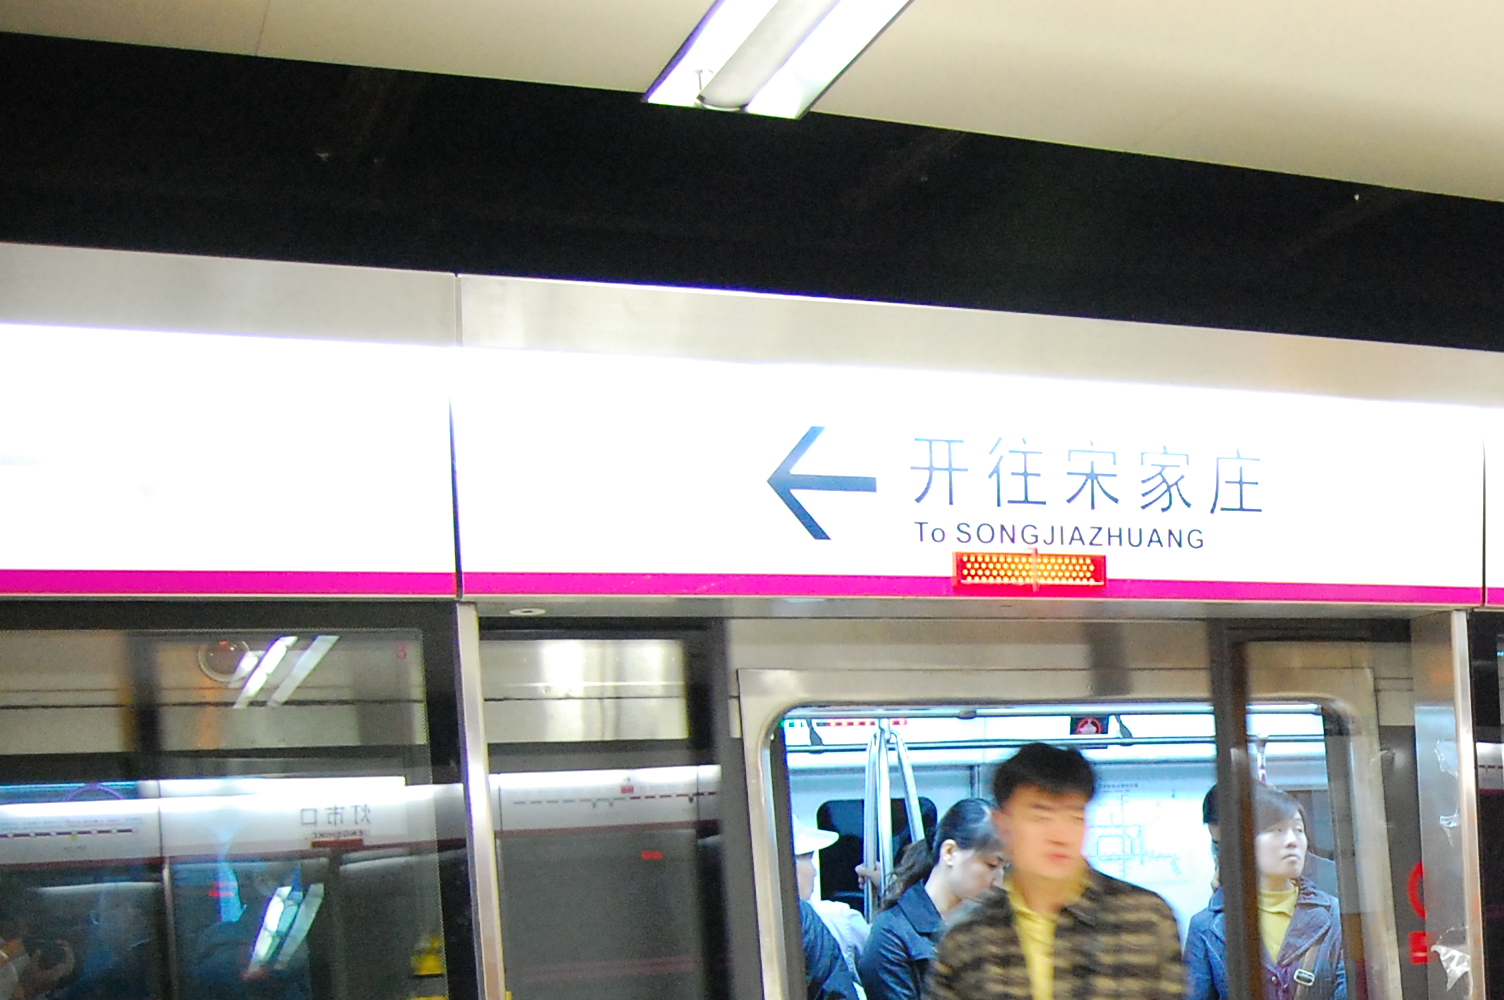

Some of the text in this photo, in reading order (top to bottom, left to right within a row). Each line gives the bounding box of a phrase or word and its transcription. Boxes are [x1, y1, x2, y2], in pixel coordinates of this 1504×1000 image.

[910, 437, 1263, 514] 开往宋家庄
[914, 521, 1205, 549] To SONGJIAZHUANG
